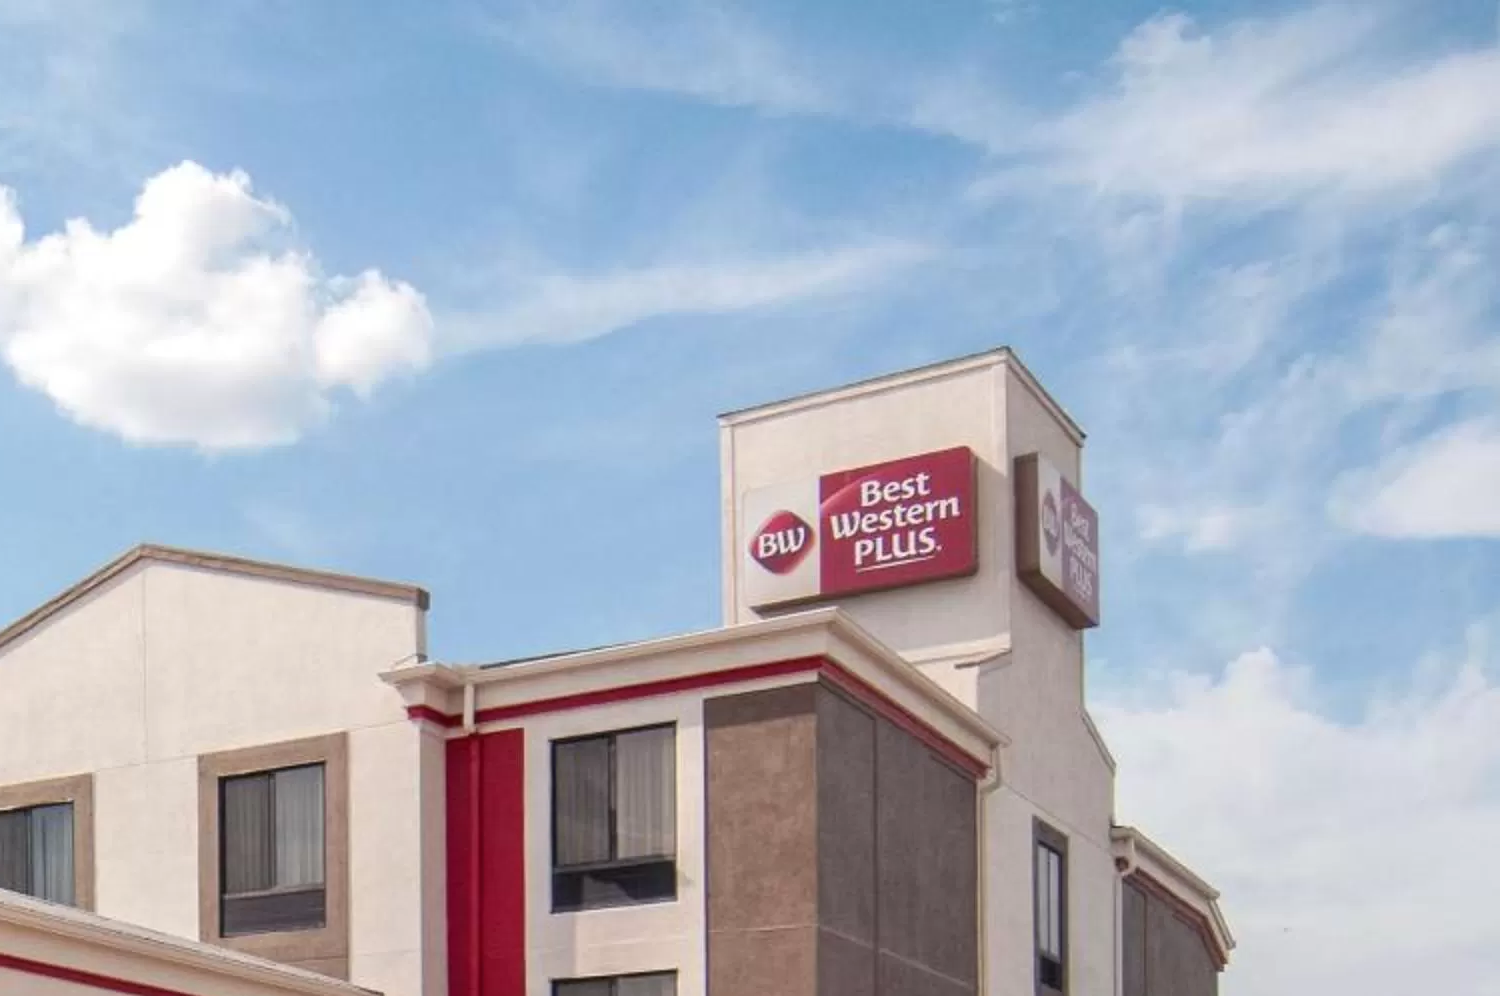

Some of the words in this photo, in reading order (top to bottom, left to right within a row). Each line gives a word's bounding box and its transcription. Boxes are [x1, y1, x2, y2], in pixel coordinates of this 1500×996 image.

[861, 472, 931, 507] Best
[830, 496, 960, 540] Western
[758, 527, 805, 558] BW
